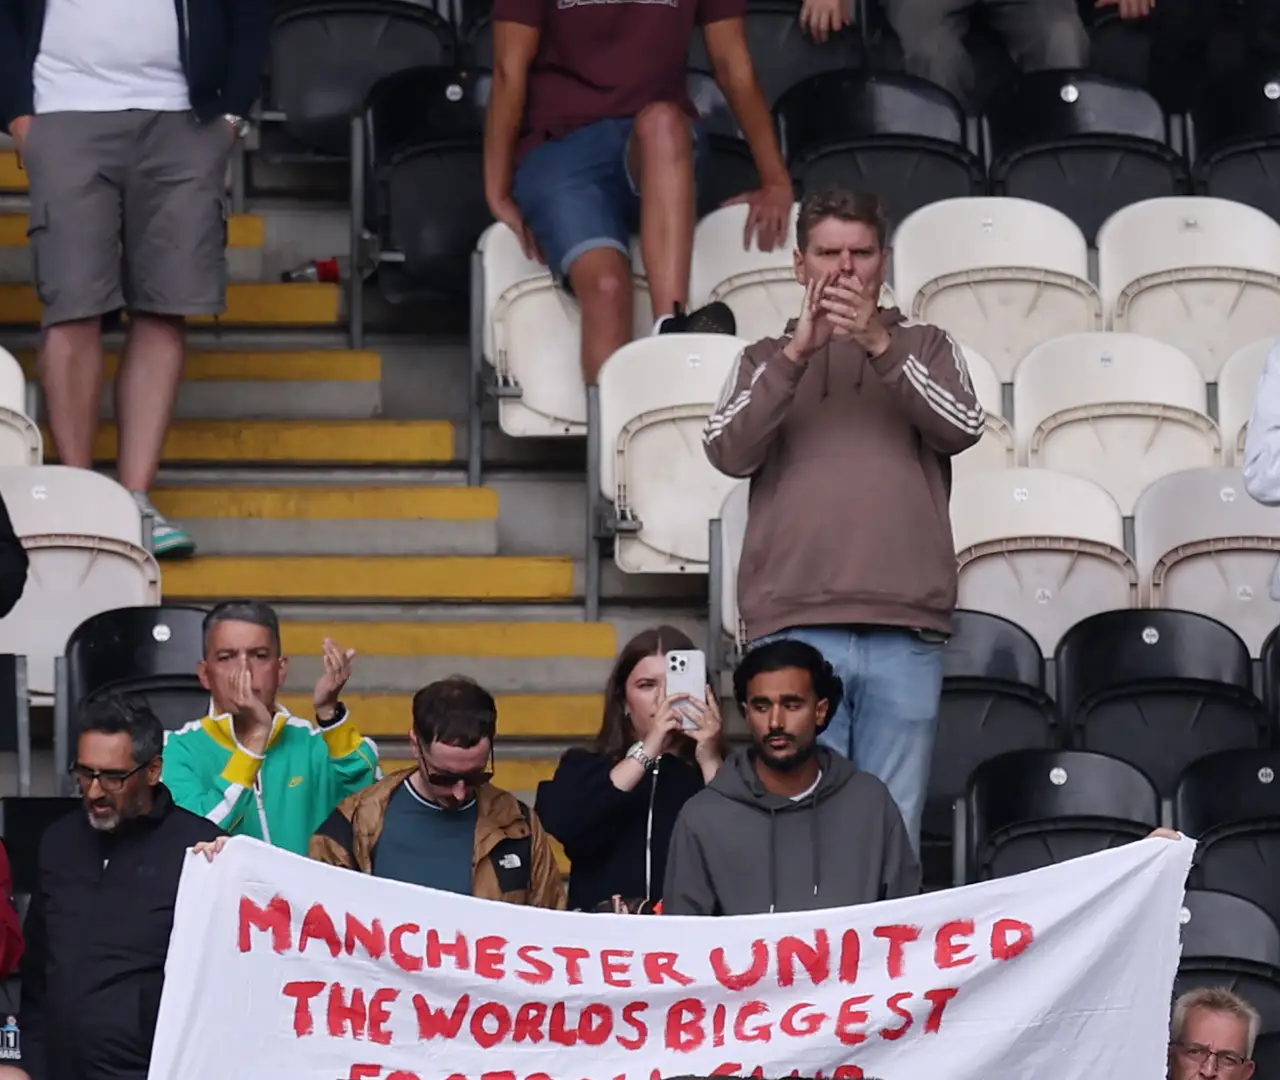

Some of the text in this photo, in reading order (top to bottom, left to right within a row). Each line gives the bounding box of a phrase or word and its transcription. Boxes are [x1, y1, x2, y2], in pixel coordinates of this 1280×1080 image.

[238, 895, 1034, 993] MANCHESTER UNITED
[283, 979, 959, 1053] THE WORLDS BIGGEST
